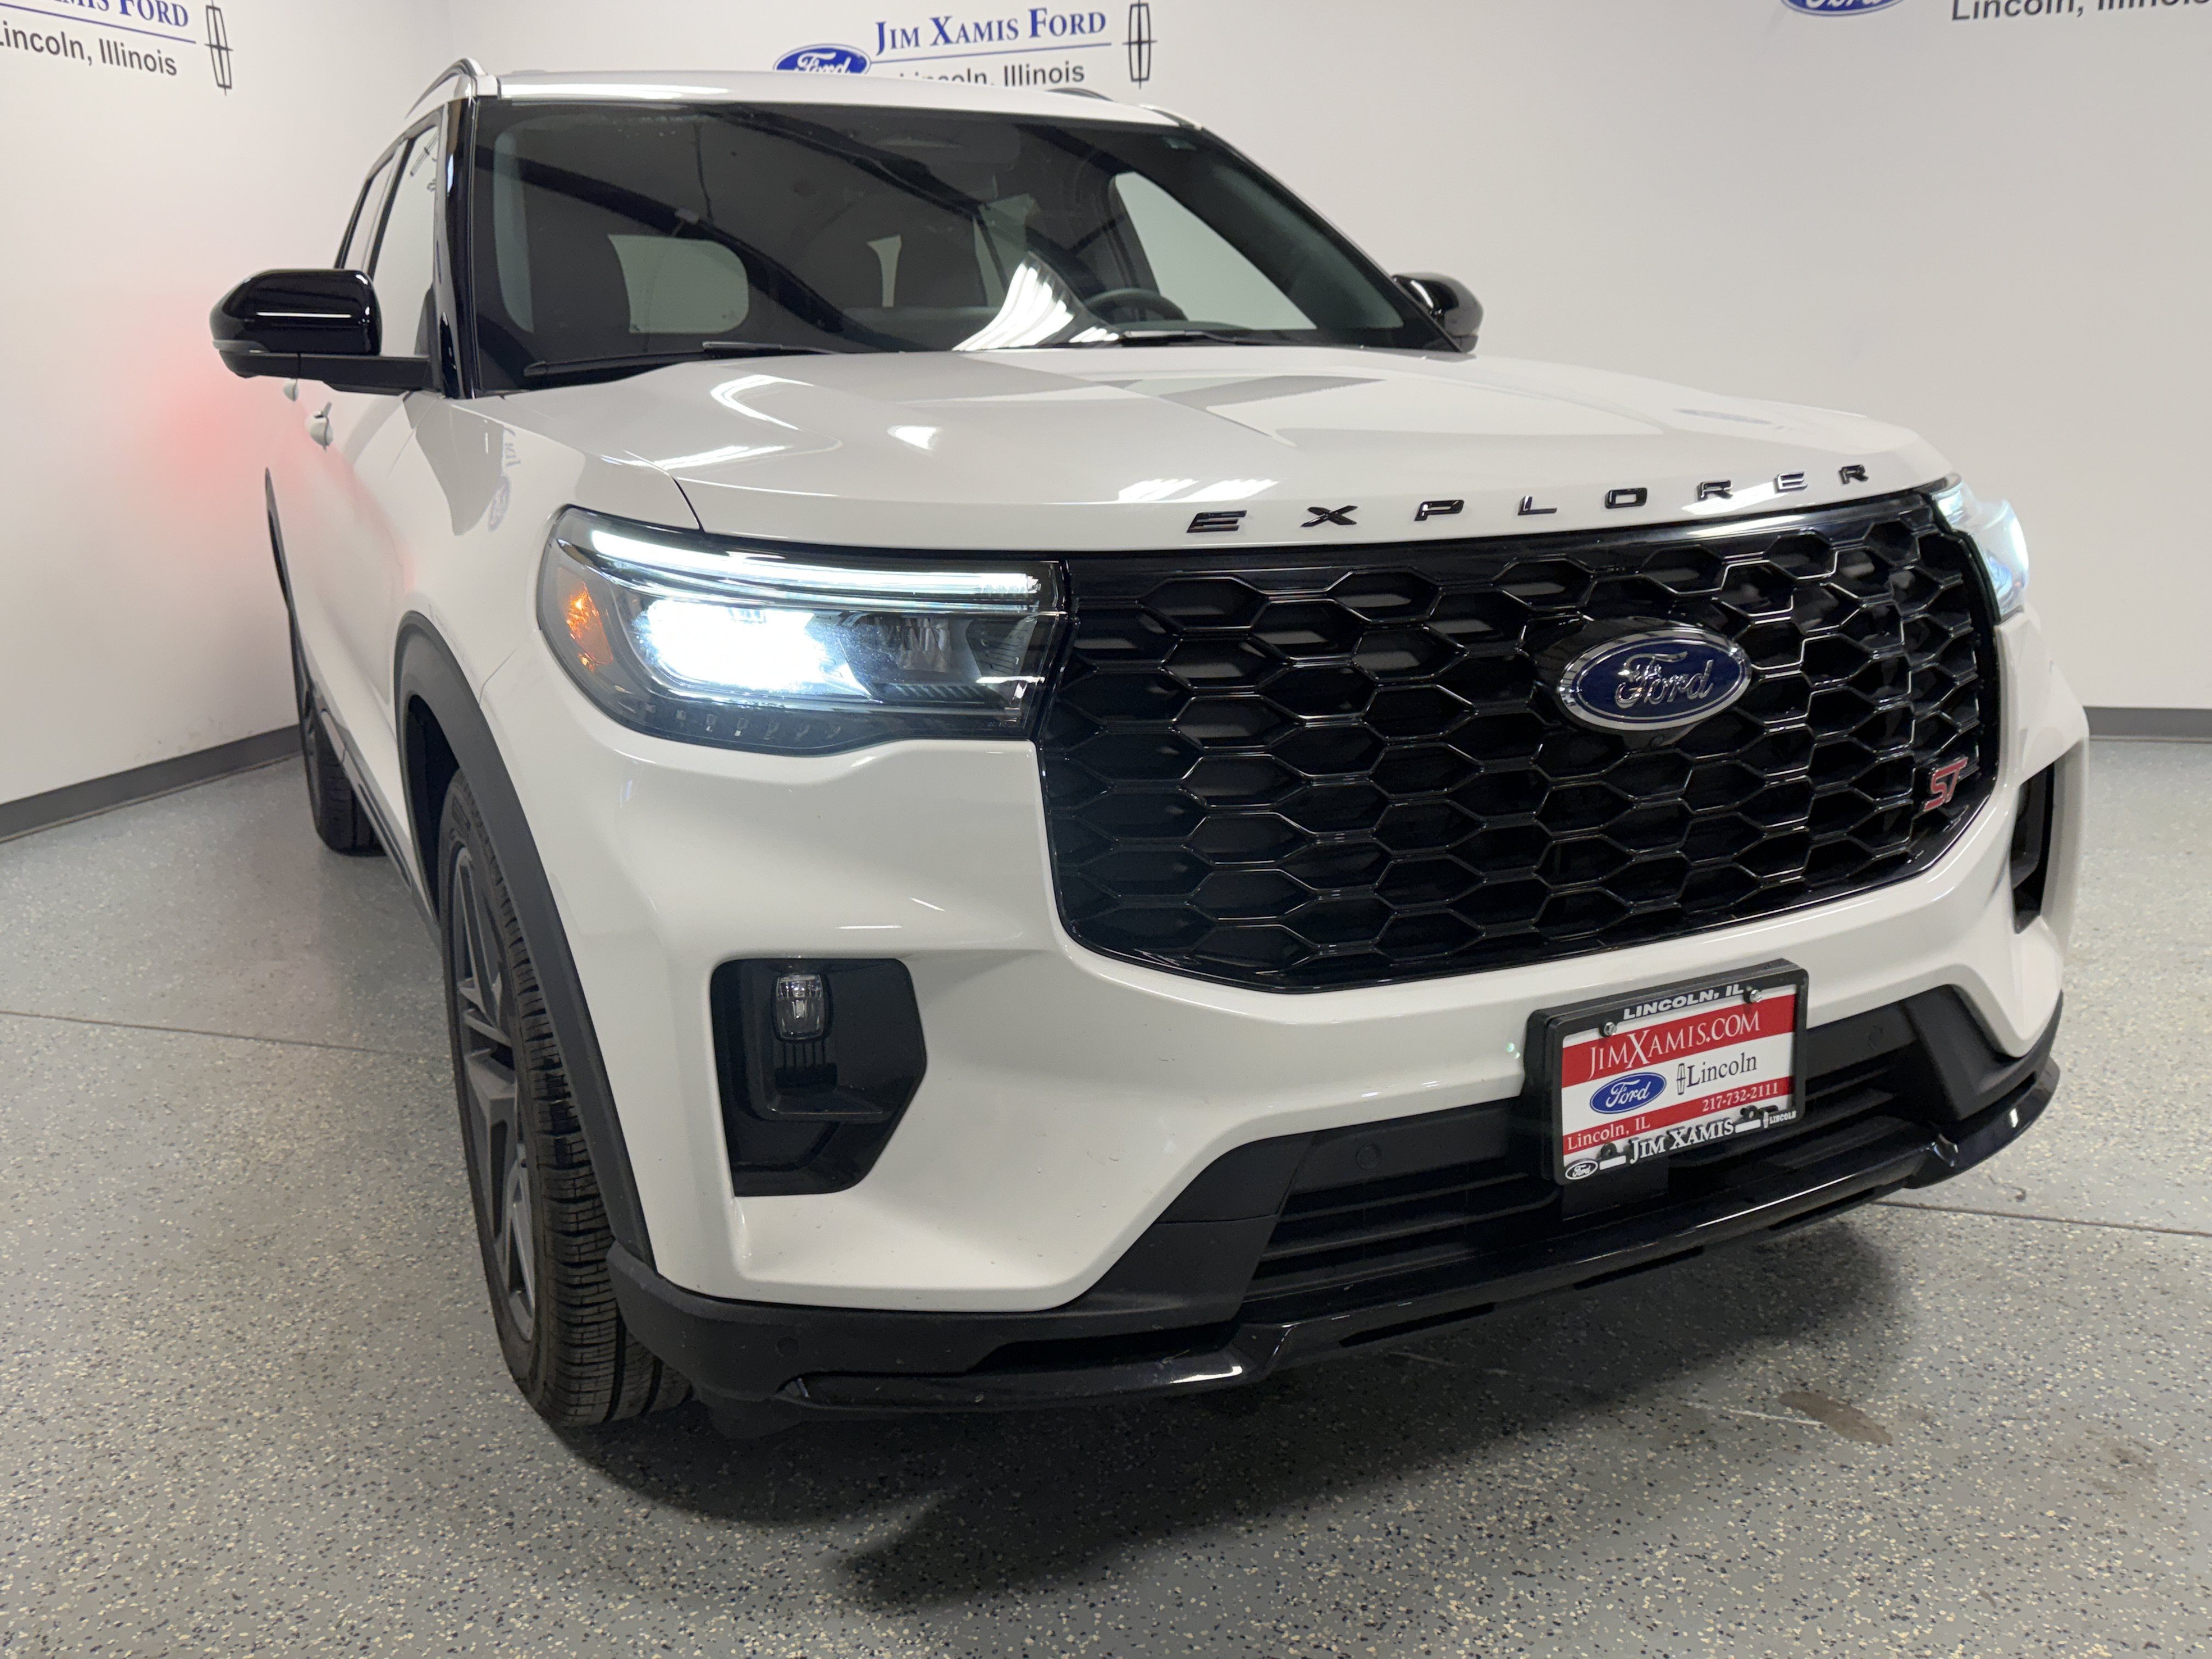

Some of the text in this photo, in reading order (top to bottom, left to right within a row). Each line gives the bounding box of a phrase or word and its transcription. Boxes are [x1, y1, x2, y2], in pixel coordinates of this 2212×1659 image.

[0, 20, 177, 76] incoln, Illinois
[875, 7, 1106, 56] JIM XAMIS FORD
[1003, 61, 1085, 87] Illinois
[1186, 464, 1869, 533] EXPLORER
[1615, 651, 1715, 709] Ford
[1922, 757, 1968, 812] ST
[1622, 984, 1744, 1020] LINCOLN, IL
[1687, 1052, 1757, 1088] Lincoln
[1605, 1079, 1652, 1108] Ford
[1702, 1082, 1779, 1112] 217-732-2111
[1567, 1116, 1651, 1151] Lincoln, IL
[1769, 1110, 1797, 1125] LINCOLN
[1629, 1119, 1734, 1164] JIM XAMIS
[1572, 1164, 1591, 1178] Ford
